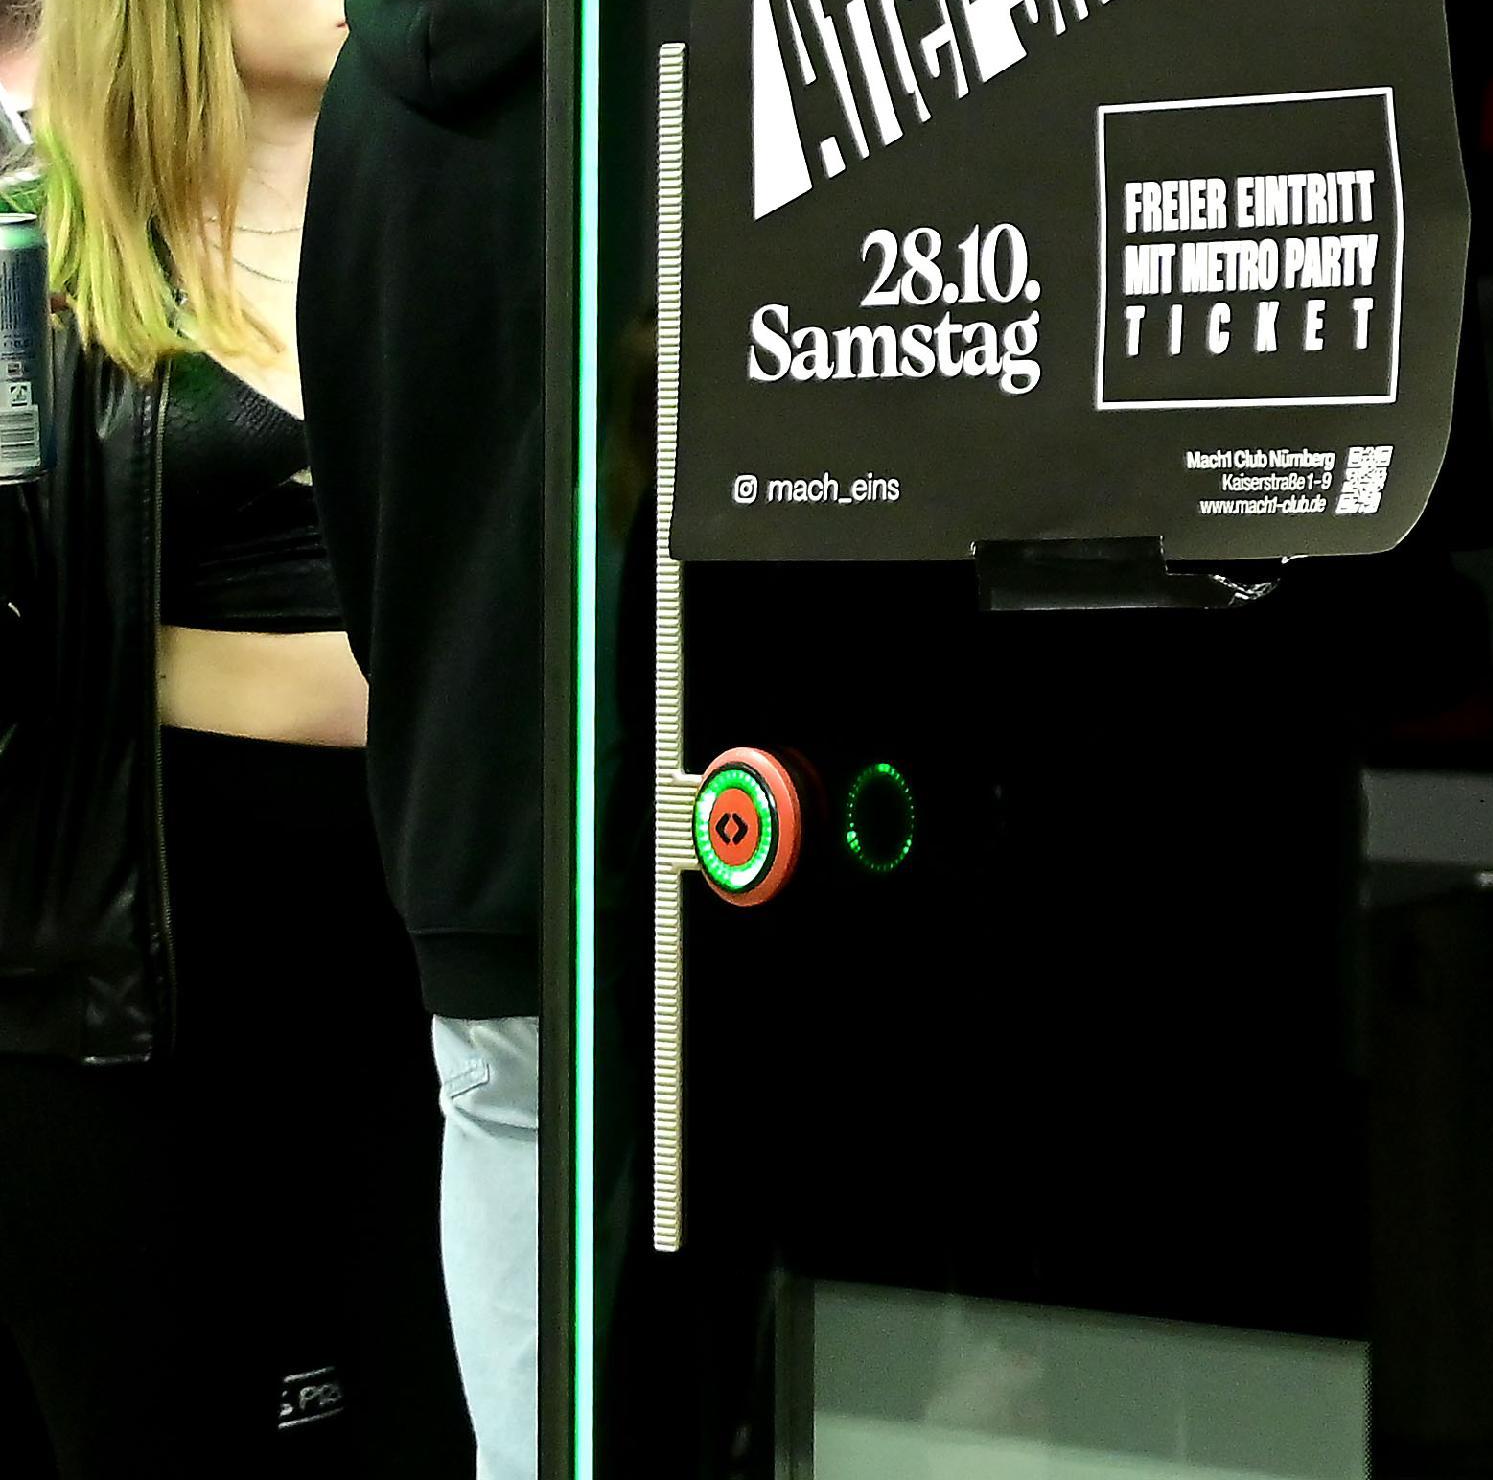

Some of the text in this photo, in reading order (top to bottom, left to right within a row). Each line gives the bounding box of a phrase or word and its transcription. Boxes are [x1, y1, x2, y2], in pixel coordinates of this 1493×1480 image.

[1125, 170, 1375, 233] FREIER EINTRITT
[860, 223, 1041, 306] 28.10.
[1124, 234, 1379, 295] MIT METRO PARTY
[749, 303, 1041, 395] Samstag
[1125, 297, 1374, 356] TICKET
[768, 472, 900, 503] mach_eins
[1186, 448, 1336, 471] Mach1 Club Nürnberg
[1222, 472, 1306, 491] Kaiserstraße
